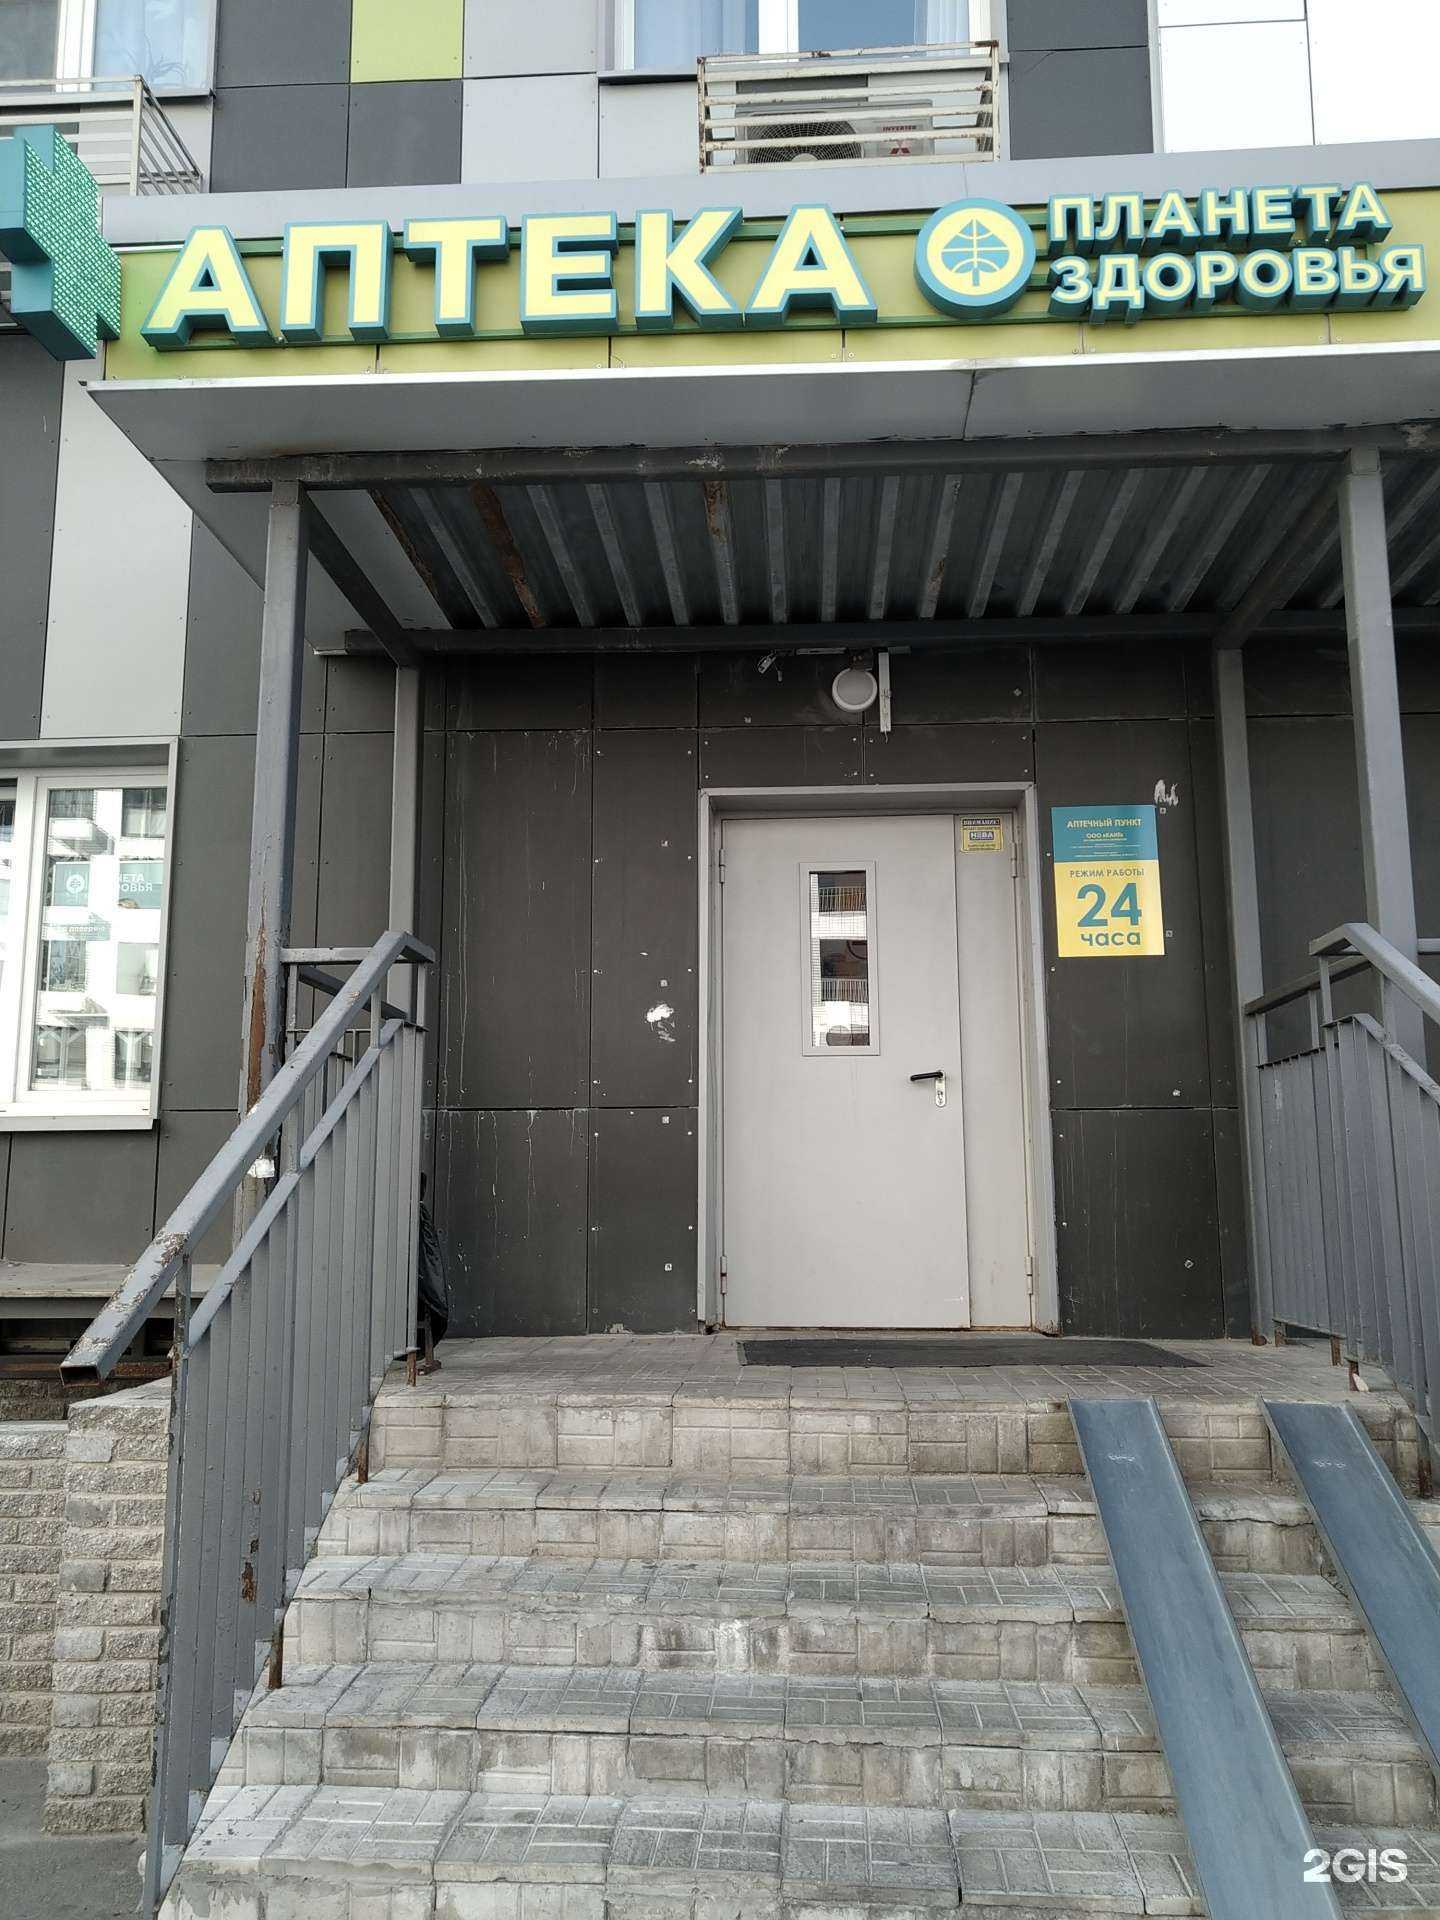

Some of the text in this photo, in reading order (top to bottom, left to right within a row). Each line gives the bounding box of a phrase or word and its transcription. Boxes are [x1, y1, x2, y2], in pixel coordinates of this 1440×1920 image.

[1048, 183, 1392, 252] ПЛАНЕТА
[140, 203, 877, 346] АПТЕКА
[1048, 244, 1427, 322] ЗДОРОВЬЯ
[1066, 818, 1142, 829] АПТЕЧНЫЙ ПУНКТ
[1070, 868, 1144, 878] РЕЖИМ РАБОТЫ
[1077, 882, 1142, 928] 24
[1081, 931, 1141, 947] часа
